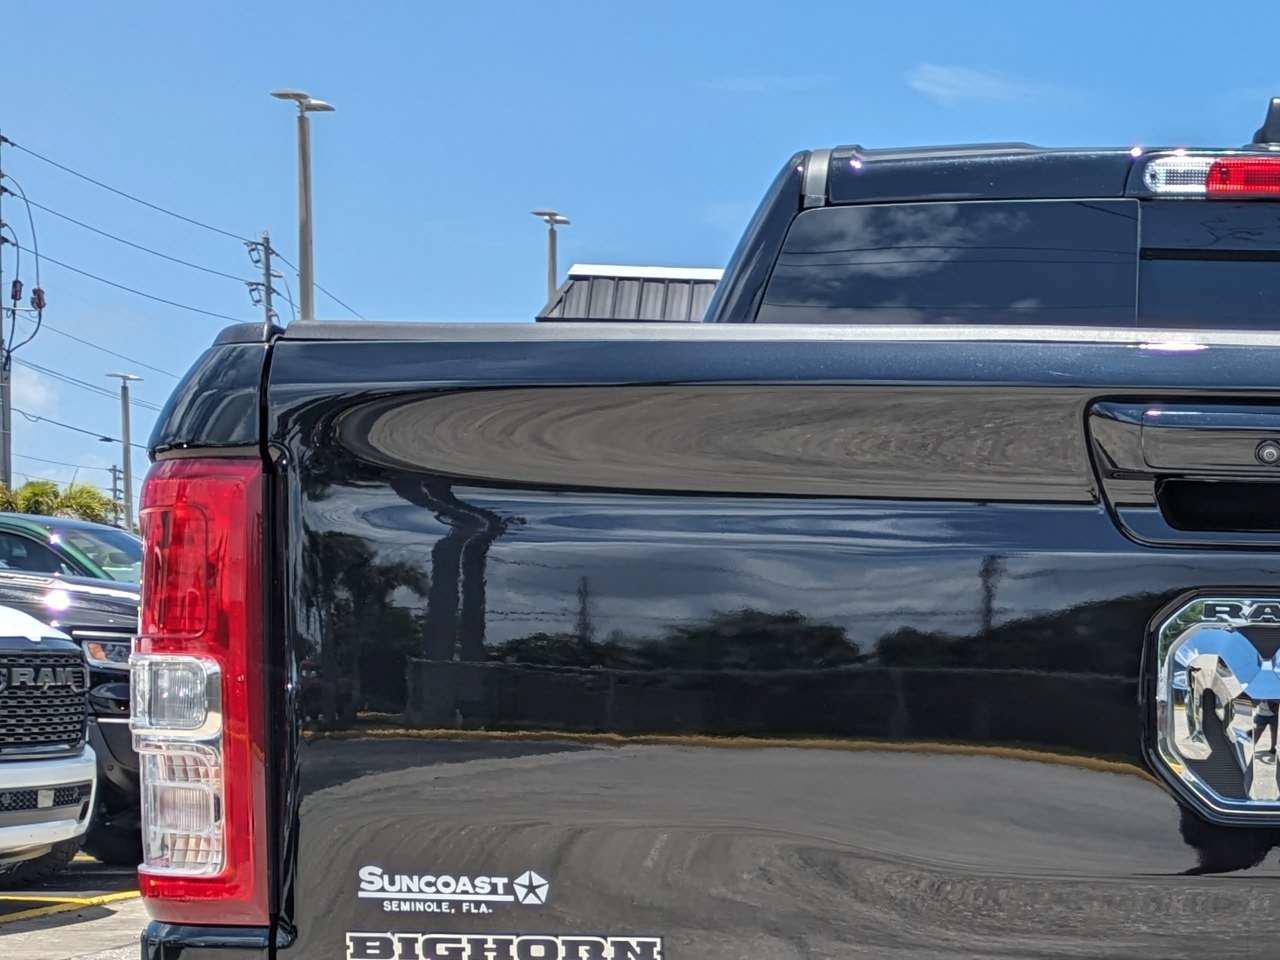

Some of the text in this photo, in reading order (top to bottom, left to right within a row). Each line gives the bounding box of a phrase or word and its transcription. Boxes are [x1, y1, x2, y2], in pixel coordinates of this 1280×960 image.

[12, 667, 74, 686] RAM
[359, 866, 509, 894] SUNCOAST
[383, 901, 493, 914] SEMINOLE, FLA.
